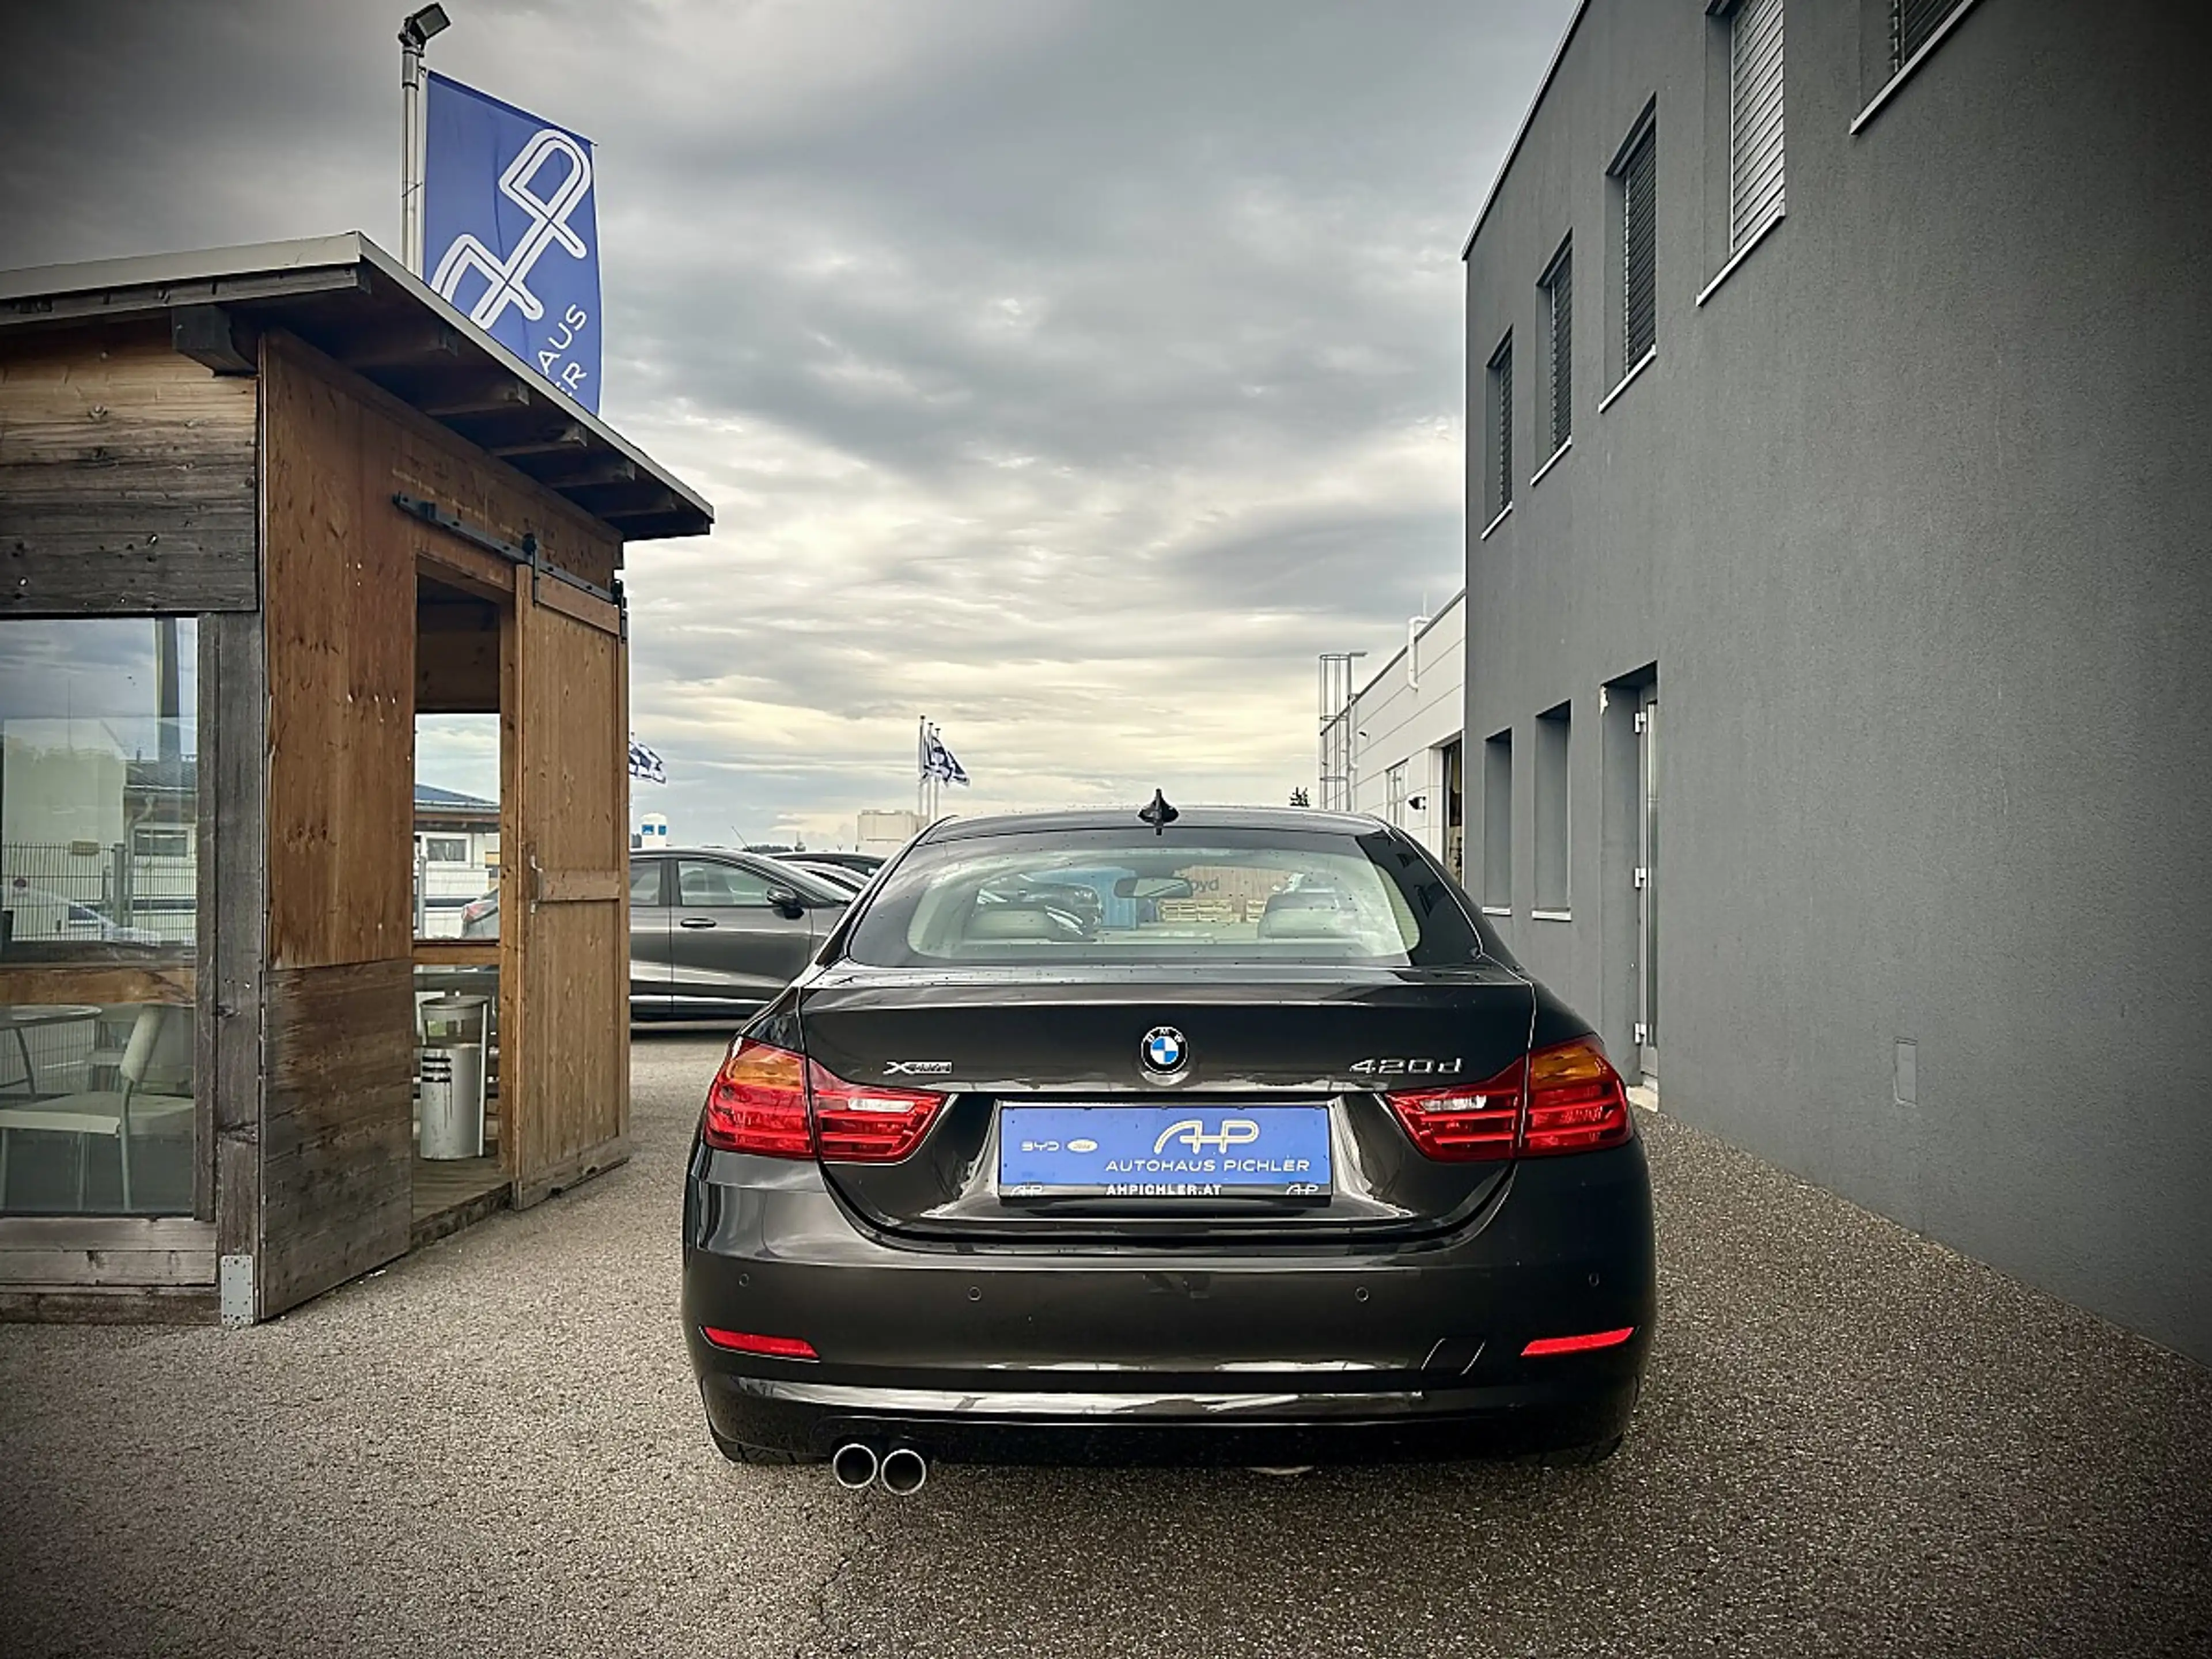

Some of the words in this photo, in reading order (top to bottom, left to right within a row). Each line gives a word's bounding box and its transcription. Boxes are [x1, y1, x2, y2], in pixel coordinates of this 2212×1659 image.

[1350, 1058, 1463, 1074] 420d
[1021, 1141, 1059, 1151] BYD
[1105, 1160, 1216, 1172] AUTOHAUS
[1224, 1159, 1310, 1172] PICHLER
[1106, 1184, 1222, 1195] AHPICHLER.AT
